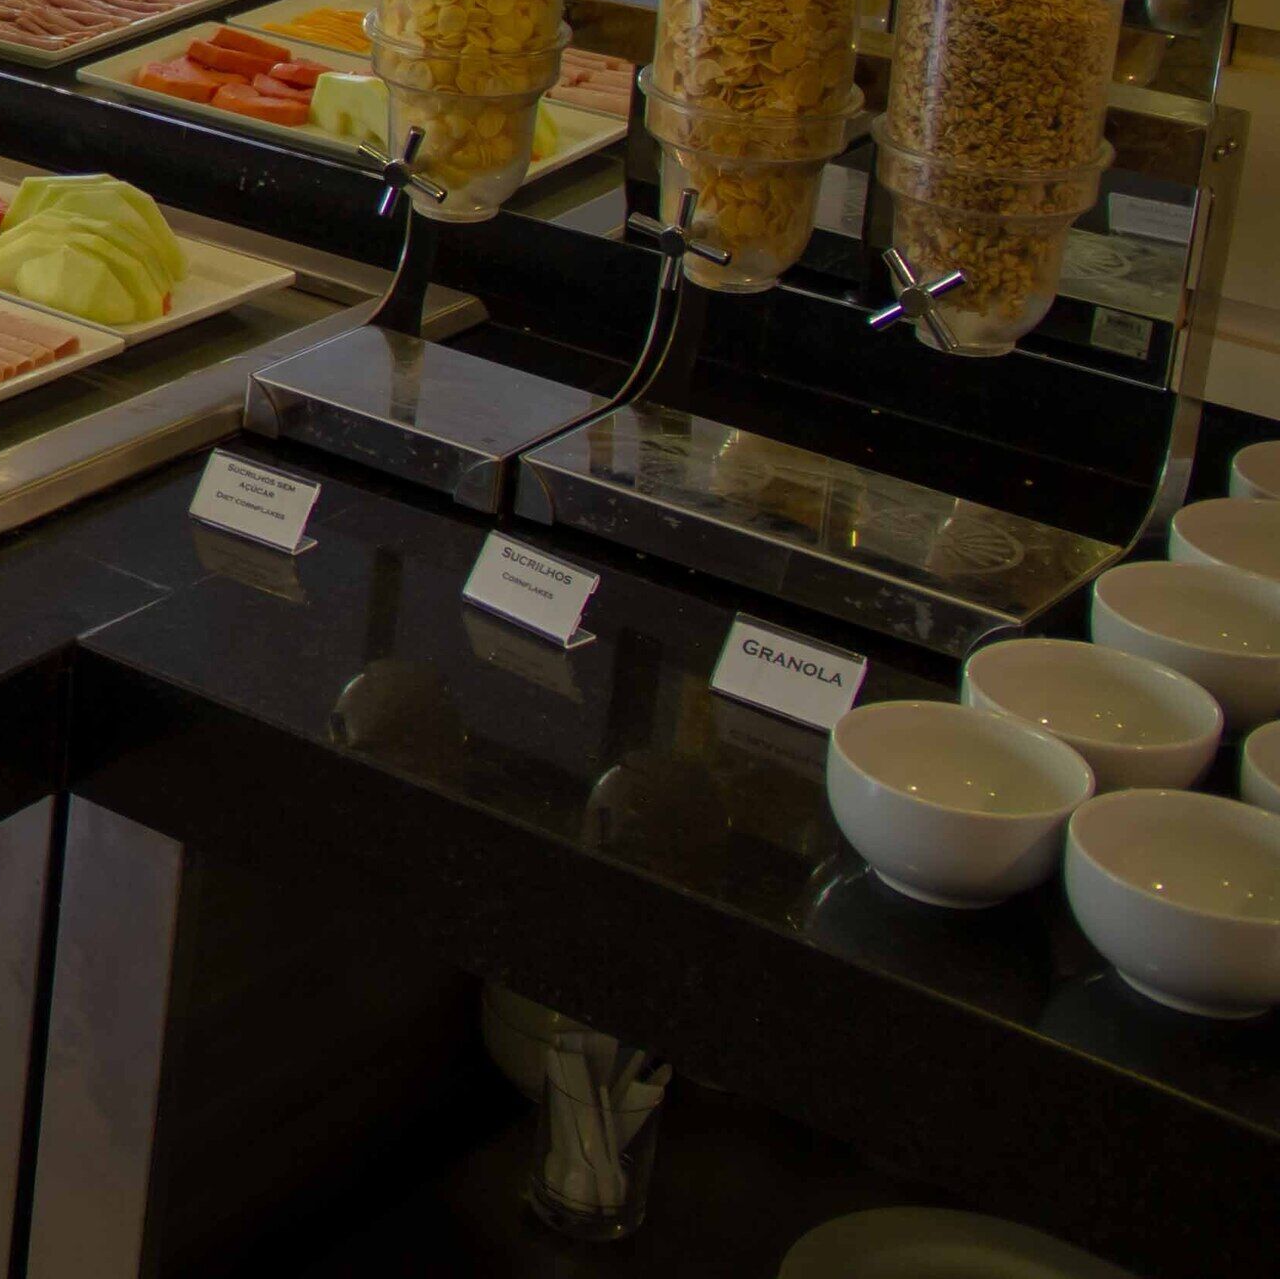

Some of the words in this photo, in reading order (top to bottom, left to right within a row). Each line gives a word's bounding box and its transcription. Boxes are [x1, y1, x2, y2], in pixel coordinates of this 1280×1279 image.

[227, 463, 276, 486] SUCRILHOS
[276, 481, 297, 493] SEM
[234, 498, 286, 521] CORNFLAKES
[501, 546, 573, 586] SUCRILHOS
[502, 571, 554, 600] CORNFLAKES
[742, 639, 843, 688] GRANOLA
